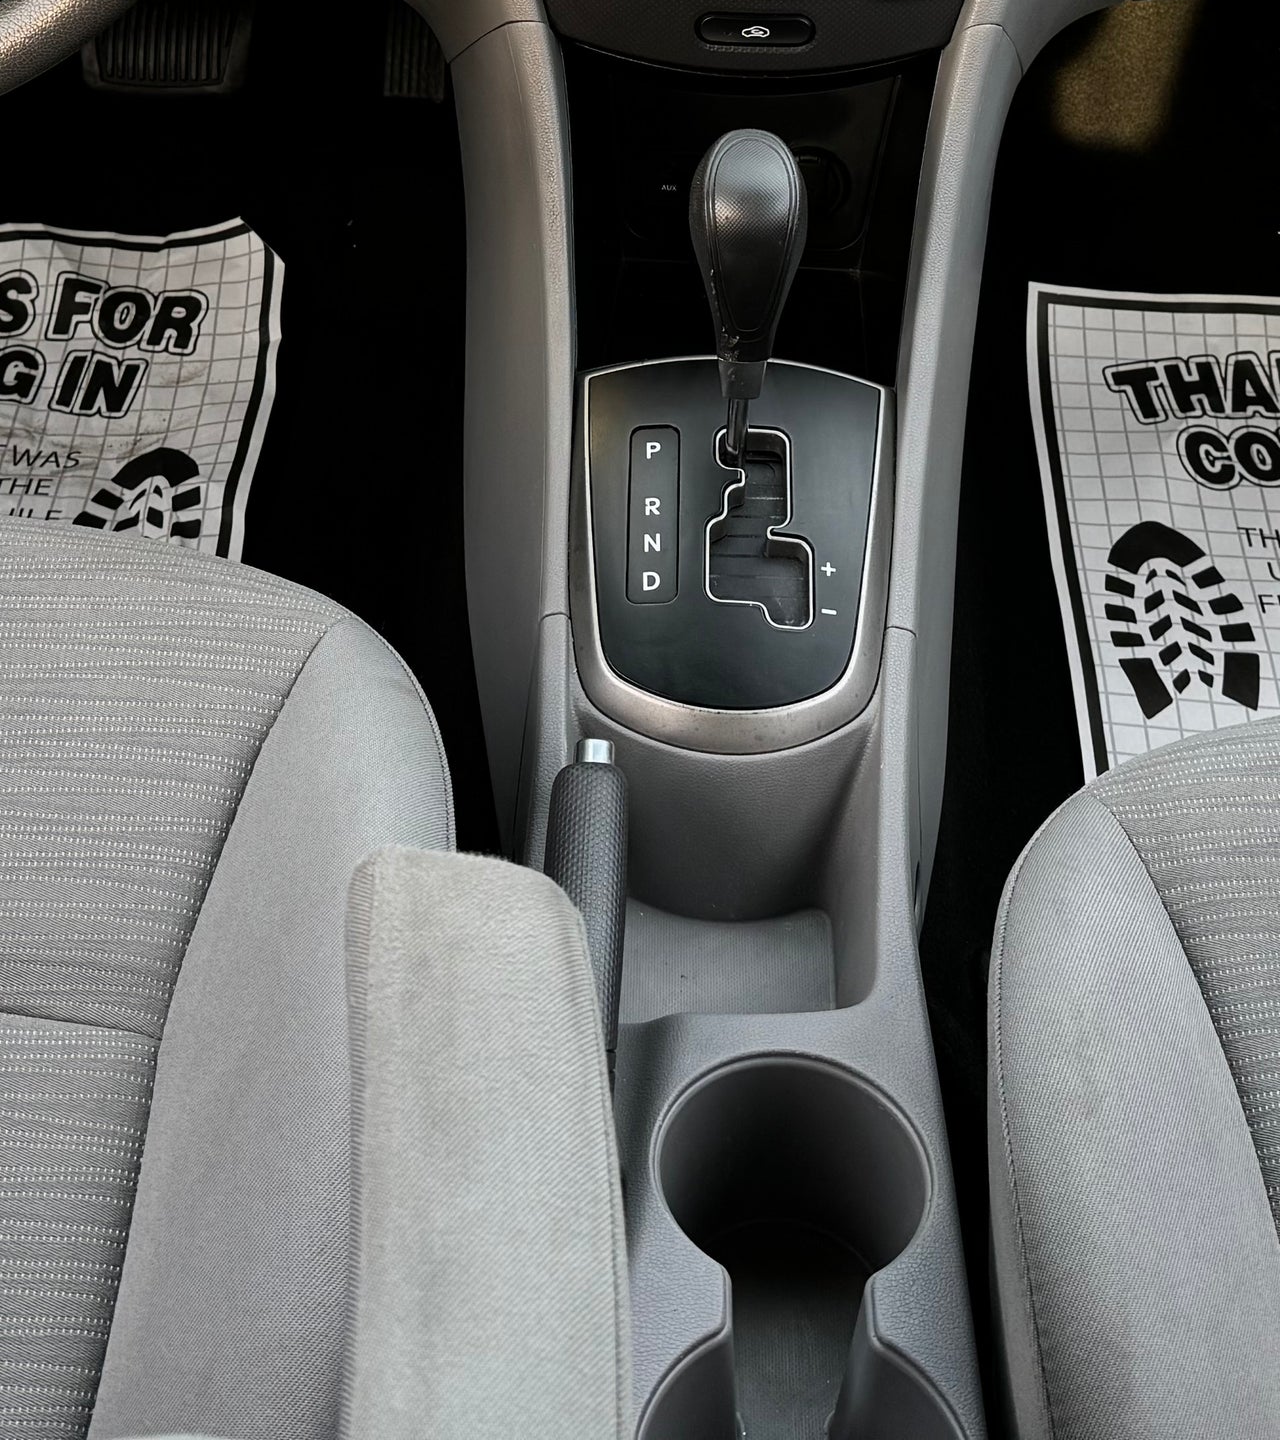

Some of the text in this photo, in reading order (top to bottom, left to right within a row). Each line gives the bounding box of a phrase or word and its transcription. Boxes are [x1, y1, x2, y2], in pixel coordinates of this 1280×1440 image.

[45, 271, 209, 355] FOR
[48, 349, 149, 419] IN
[10, 445, 82, 469] WAS
[645, 441, 661, 459] P
[644, 497, 661, 516] R
[643, 533, 661, 553] N
[642, 571, 661, 591] D
